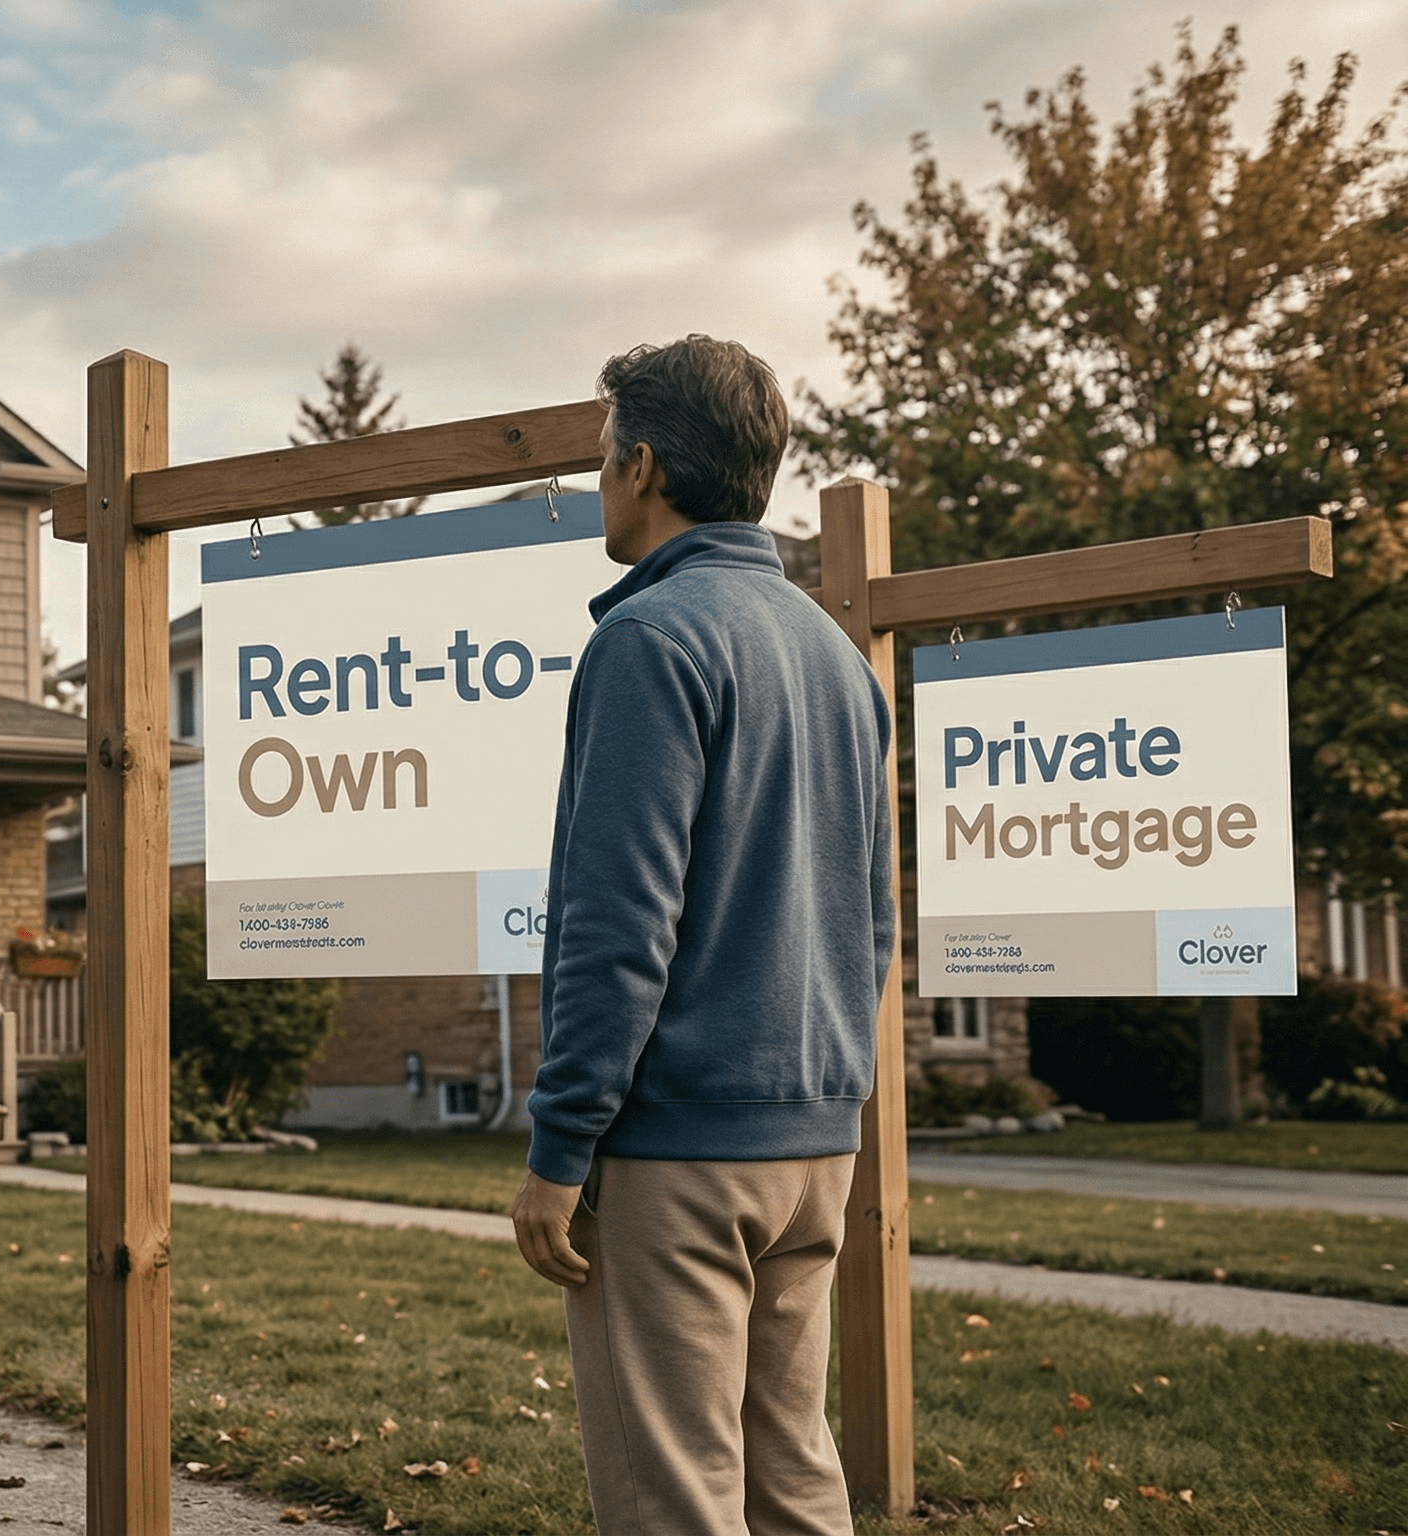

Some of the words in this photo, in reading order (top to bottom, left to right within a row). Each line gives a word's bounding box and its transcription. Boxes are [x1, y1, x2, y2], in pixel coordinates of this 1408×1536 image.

[238, 629, 573, 721] Rent-to-
[238, 736, 429, 818] Own
[944, 717, 1182, 790] Private
[945, 801, 1258, 871] Mortgage
[503, 906, 548, 937] Clo
[1178, 938, 1268, 966] Clover
